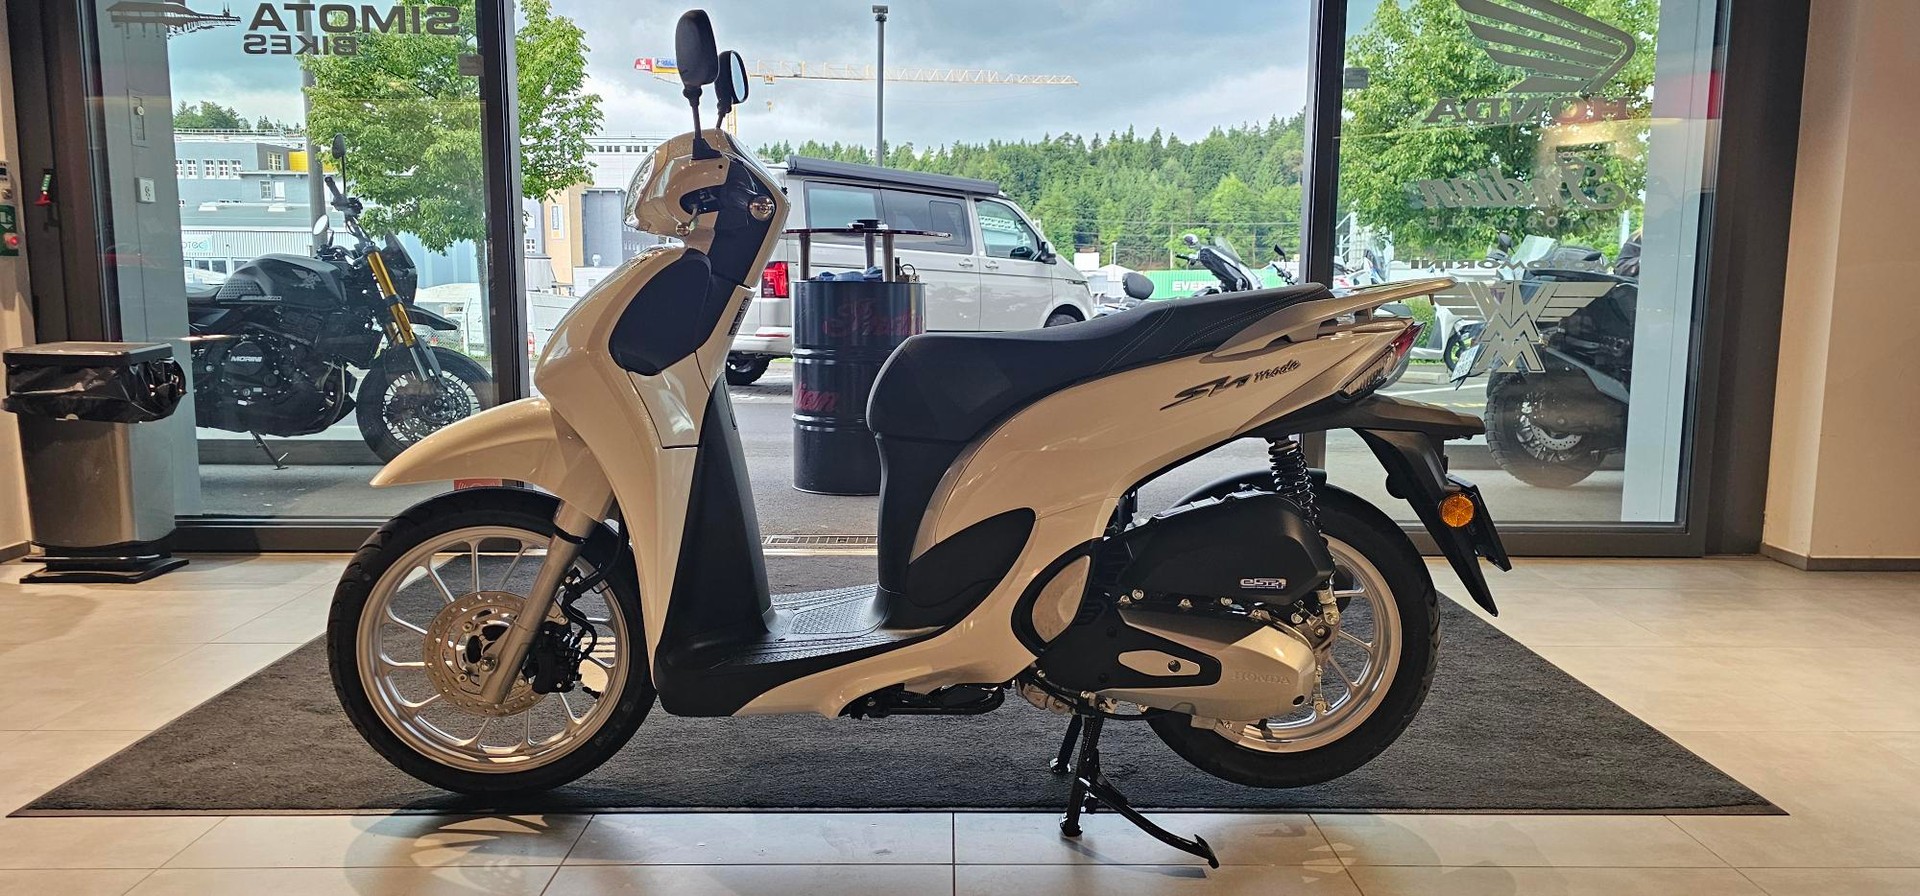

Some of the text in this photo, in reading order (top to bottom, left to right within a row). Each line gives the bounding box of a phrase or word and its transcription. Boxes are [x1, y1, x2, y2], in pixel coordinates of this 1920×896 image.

[230, 355, 263, 363] MORINI
[1253, 359, 1301, 383] mode
[1233, 671, 1291, 685] HONDA
